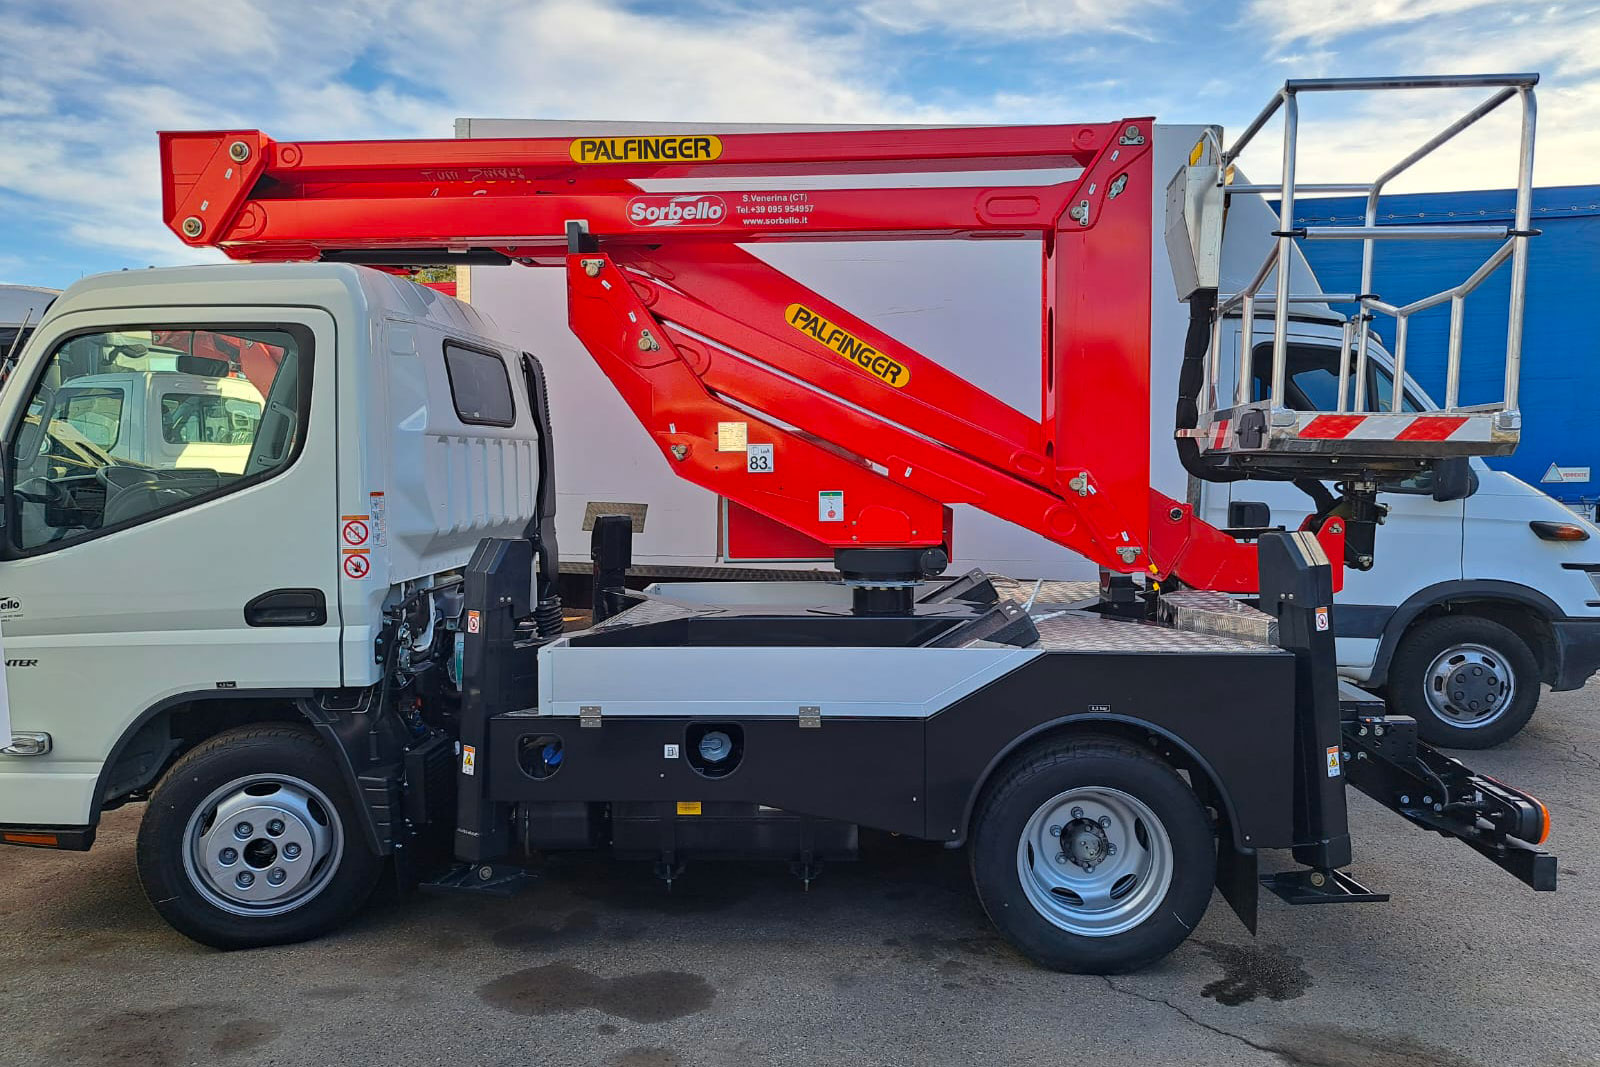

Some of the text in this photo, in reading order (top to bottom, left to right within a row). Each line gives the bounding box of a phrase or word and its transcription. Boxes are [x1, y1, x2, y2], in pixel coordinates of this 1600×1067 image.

[580, 138, 712, 161] PALFINGER
[742, 193, 808, 203] S.Venerina (CT)
[630, 201, 723, 220] Sorbello
[735, 204, 815, 214] Tel.+39 095 954957
[742, 216, 808, 225] www.sorbello.it
[791, 306, 902, 384] PALFINGER
[750, 455, 768, 470] 83
